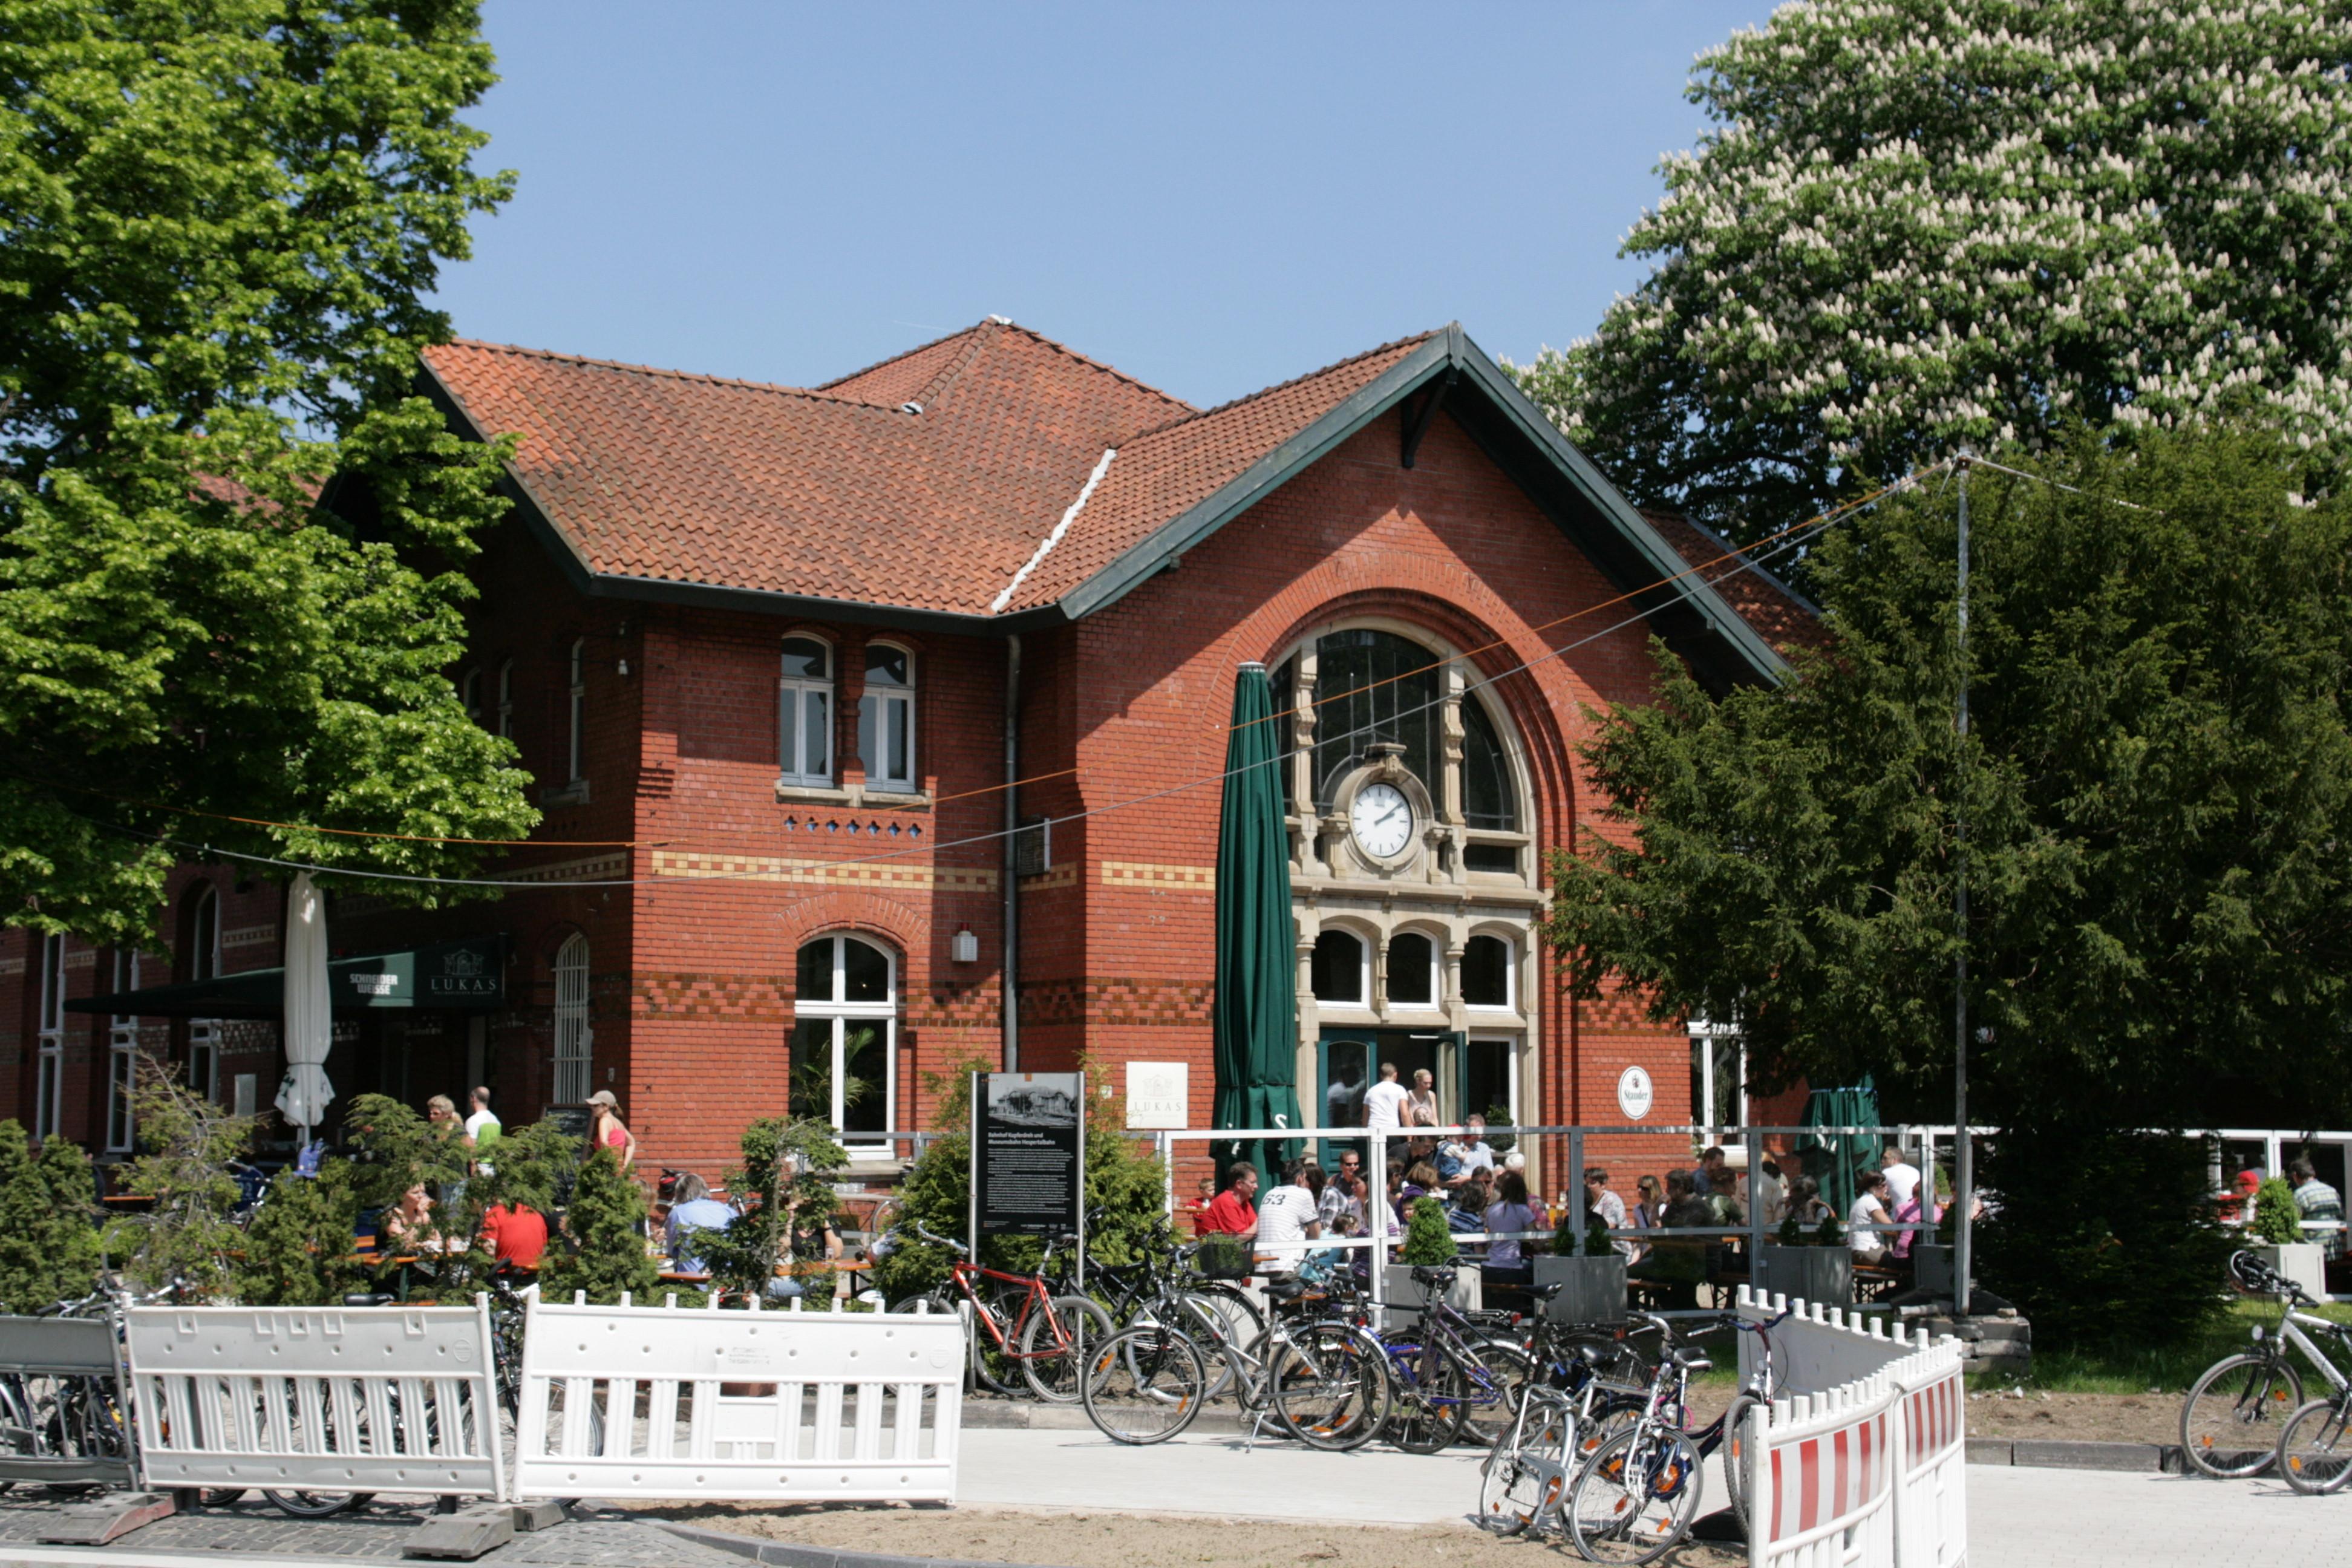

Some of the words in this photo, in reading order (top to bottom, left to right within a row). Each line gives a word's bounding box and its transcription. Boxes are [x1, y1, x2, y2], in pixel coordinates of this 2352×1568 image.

[349, 973, 398, 985] SCHNEIDER
[431, 978, 497, 990] LUKAS
[357, 984, 391, 995] WEISSE
[1624, 1089, 1648, 1101] Stauder
[1134, 1102, 1181, 1111] LUKAS
[1263, 1194, 1286, 1205] 63
